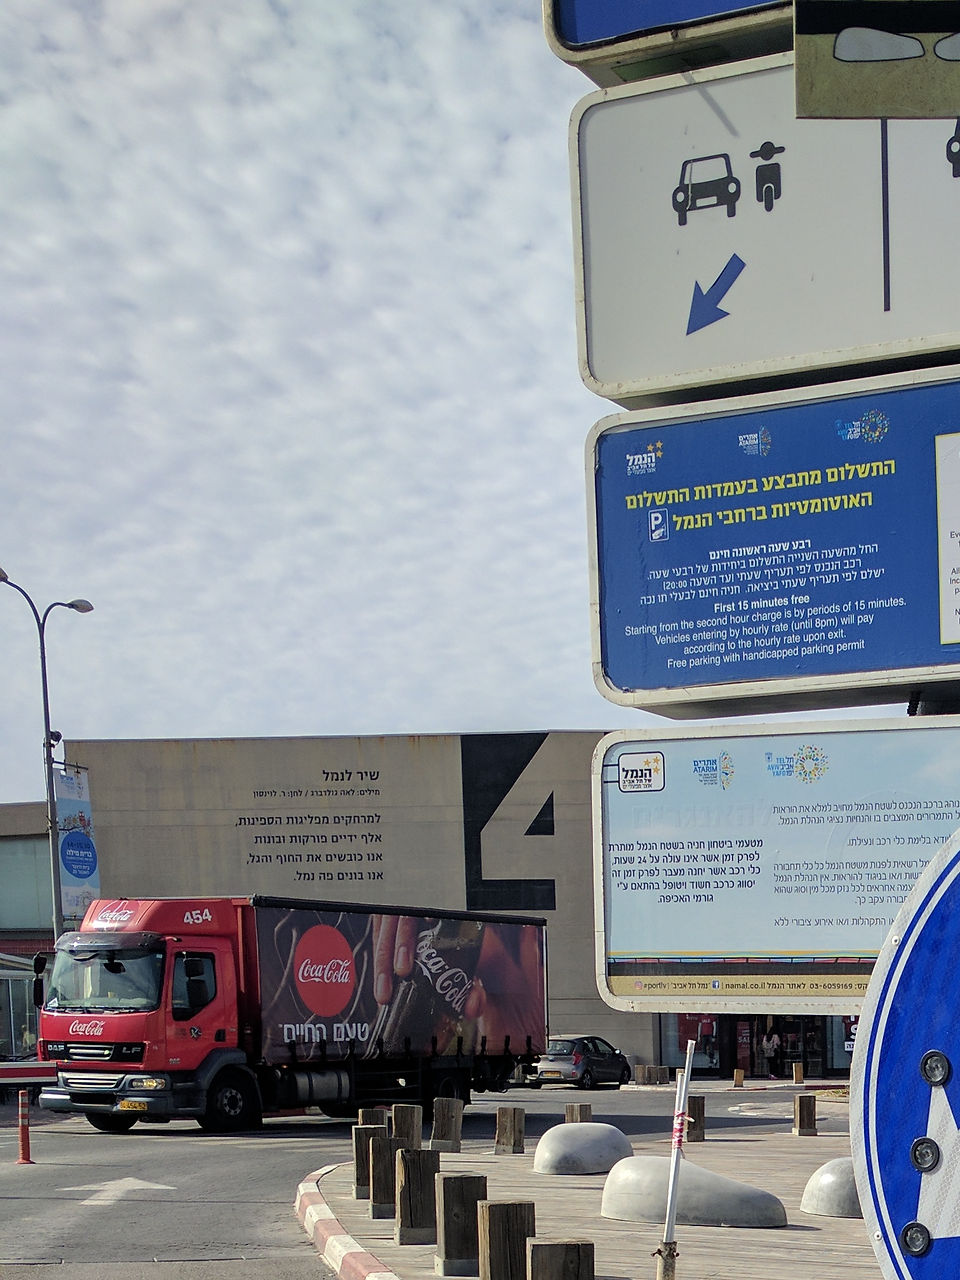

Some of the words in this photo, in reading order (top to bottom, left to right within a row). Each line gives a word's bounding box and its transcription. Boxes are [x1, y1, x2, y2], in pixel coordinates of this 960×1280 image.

[626, 452, 655, 466] הנמל
[825, 459, 896, 482] התשלום
[761, 470, 822, 491] מתבצע
[693, 478, 758, 500] בעמדות
[625, 488, 690, 509] התשלום
[771, 491, 873, 518] האוטומטיות
[716, 505, 767, 524] ברחבי
[672, 512, 713, 530] הנמל
[768, 542, 791, 552] שעה
[791, 539, 811, 550] רבע
[708, 549, 732, 560] חינם
[732, 545, 767, 557] ראשונה
[712, 602, 736, 613] First
[738, 600, 749, 610] 15
[749, 597, 789, 609] minutes
[789, 594, 809, 604] free
[624, 625, 658, 636] Starting
[659, 622, 678, 632] from
[679, 619, 695, 629] the
[695, 615, 728, 628] second
[728, 614, 749, 624] hour
[750, 611, 783, 622] charge
[782, 608, 792, 618] is
[792, 607, 805, 619] by
[805, 603, 841, 618] periods
[841, 601, 852, 612] of
[854, 600, 866, 610] 15
[866, 597, 907, 609] minutes.
[653, 633, 690, 644] Vehicles
[691, 630, 728, 641] entering
[729, 627, 741, 639] by
[741, 624, 770, 636] hourly
[770, 622, 789, 632] rate
[789, 618, 813, 632] (until
[813, 616, 839, 629] 8pm)
[839, 614, 855, 625] will
[856, 614, 875, 625] pay
[683, 642, 726, 654] according
[726, 640, 736, 650] to
[736, 639, 752, 648] the
[752, 635, 782, 647] hourly
[782, 634, 801, 644] rate
[801, 632, 826, 643] upon
[826, 628, 847, 639] exit.
[666, 658, 688, 668] Free
[689, 654, 722, 668] parking
[721, 652, 741, 662] with
[741, 645, 800, 660] handicapped
[799, 644, 835, 657] parking
[835, 639, 865, 653] permit
[322, 769, 352, 781] לנמל
[356, 771, 379, 781] שיר
[621, 767, 652, 779] הנמל
[286, 814, 330, 824] מפליגות
[333, 813, 381, 826] למרחקים
[254, 835, 285, 844] ובונות
[289, 835, 328, 845] פורקות
[331, 834, 357, 843] ידיים
[361, 832, 382, 844] אלף
[735, 839, 764, 848] מטעמי
[608, 843, 635, 852] מותרת
[636, 840, 658, 850] הנמל
[660, 841, 685, 850] בשטח
[687, 841, 705, 849] חניה
[707, 840, 733, 851] ביטחון
[276, 854, 303, 864] החוף
[306, 854, 321, 862] את
[324, 853, 363, 862] כובשים
[366, 852, 382, 861] אנו
[317, 872, 334, 880] פה
[337, 872, 364, 880] בונים
[367, 871, 383, 880] אנו
[691, 894, 714, 902] גורמי
[183, 908, 212, 924] 454
[298, 957, 351, 983] Coca-Cola
[725, 981, 765, 990] namal.co.il
[283, 1023, 327, 1043] החיים
[333, 1022, 369, 1042] טעם
